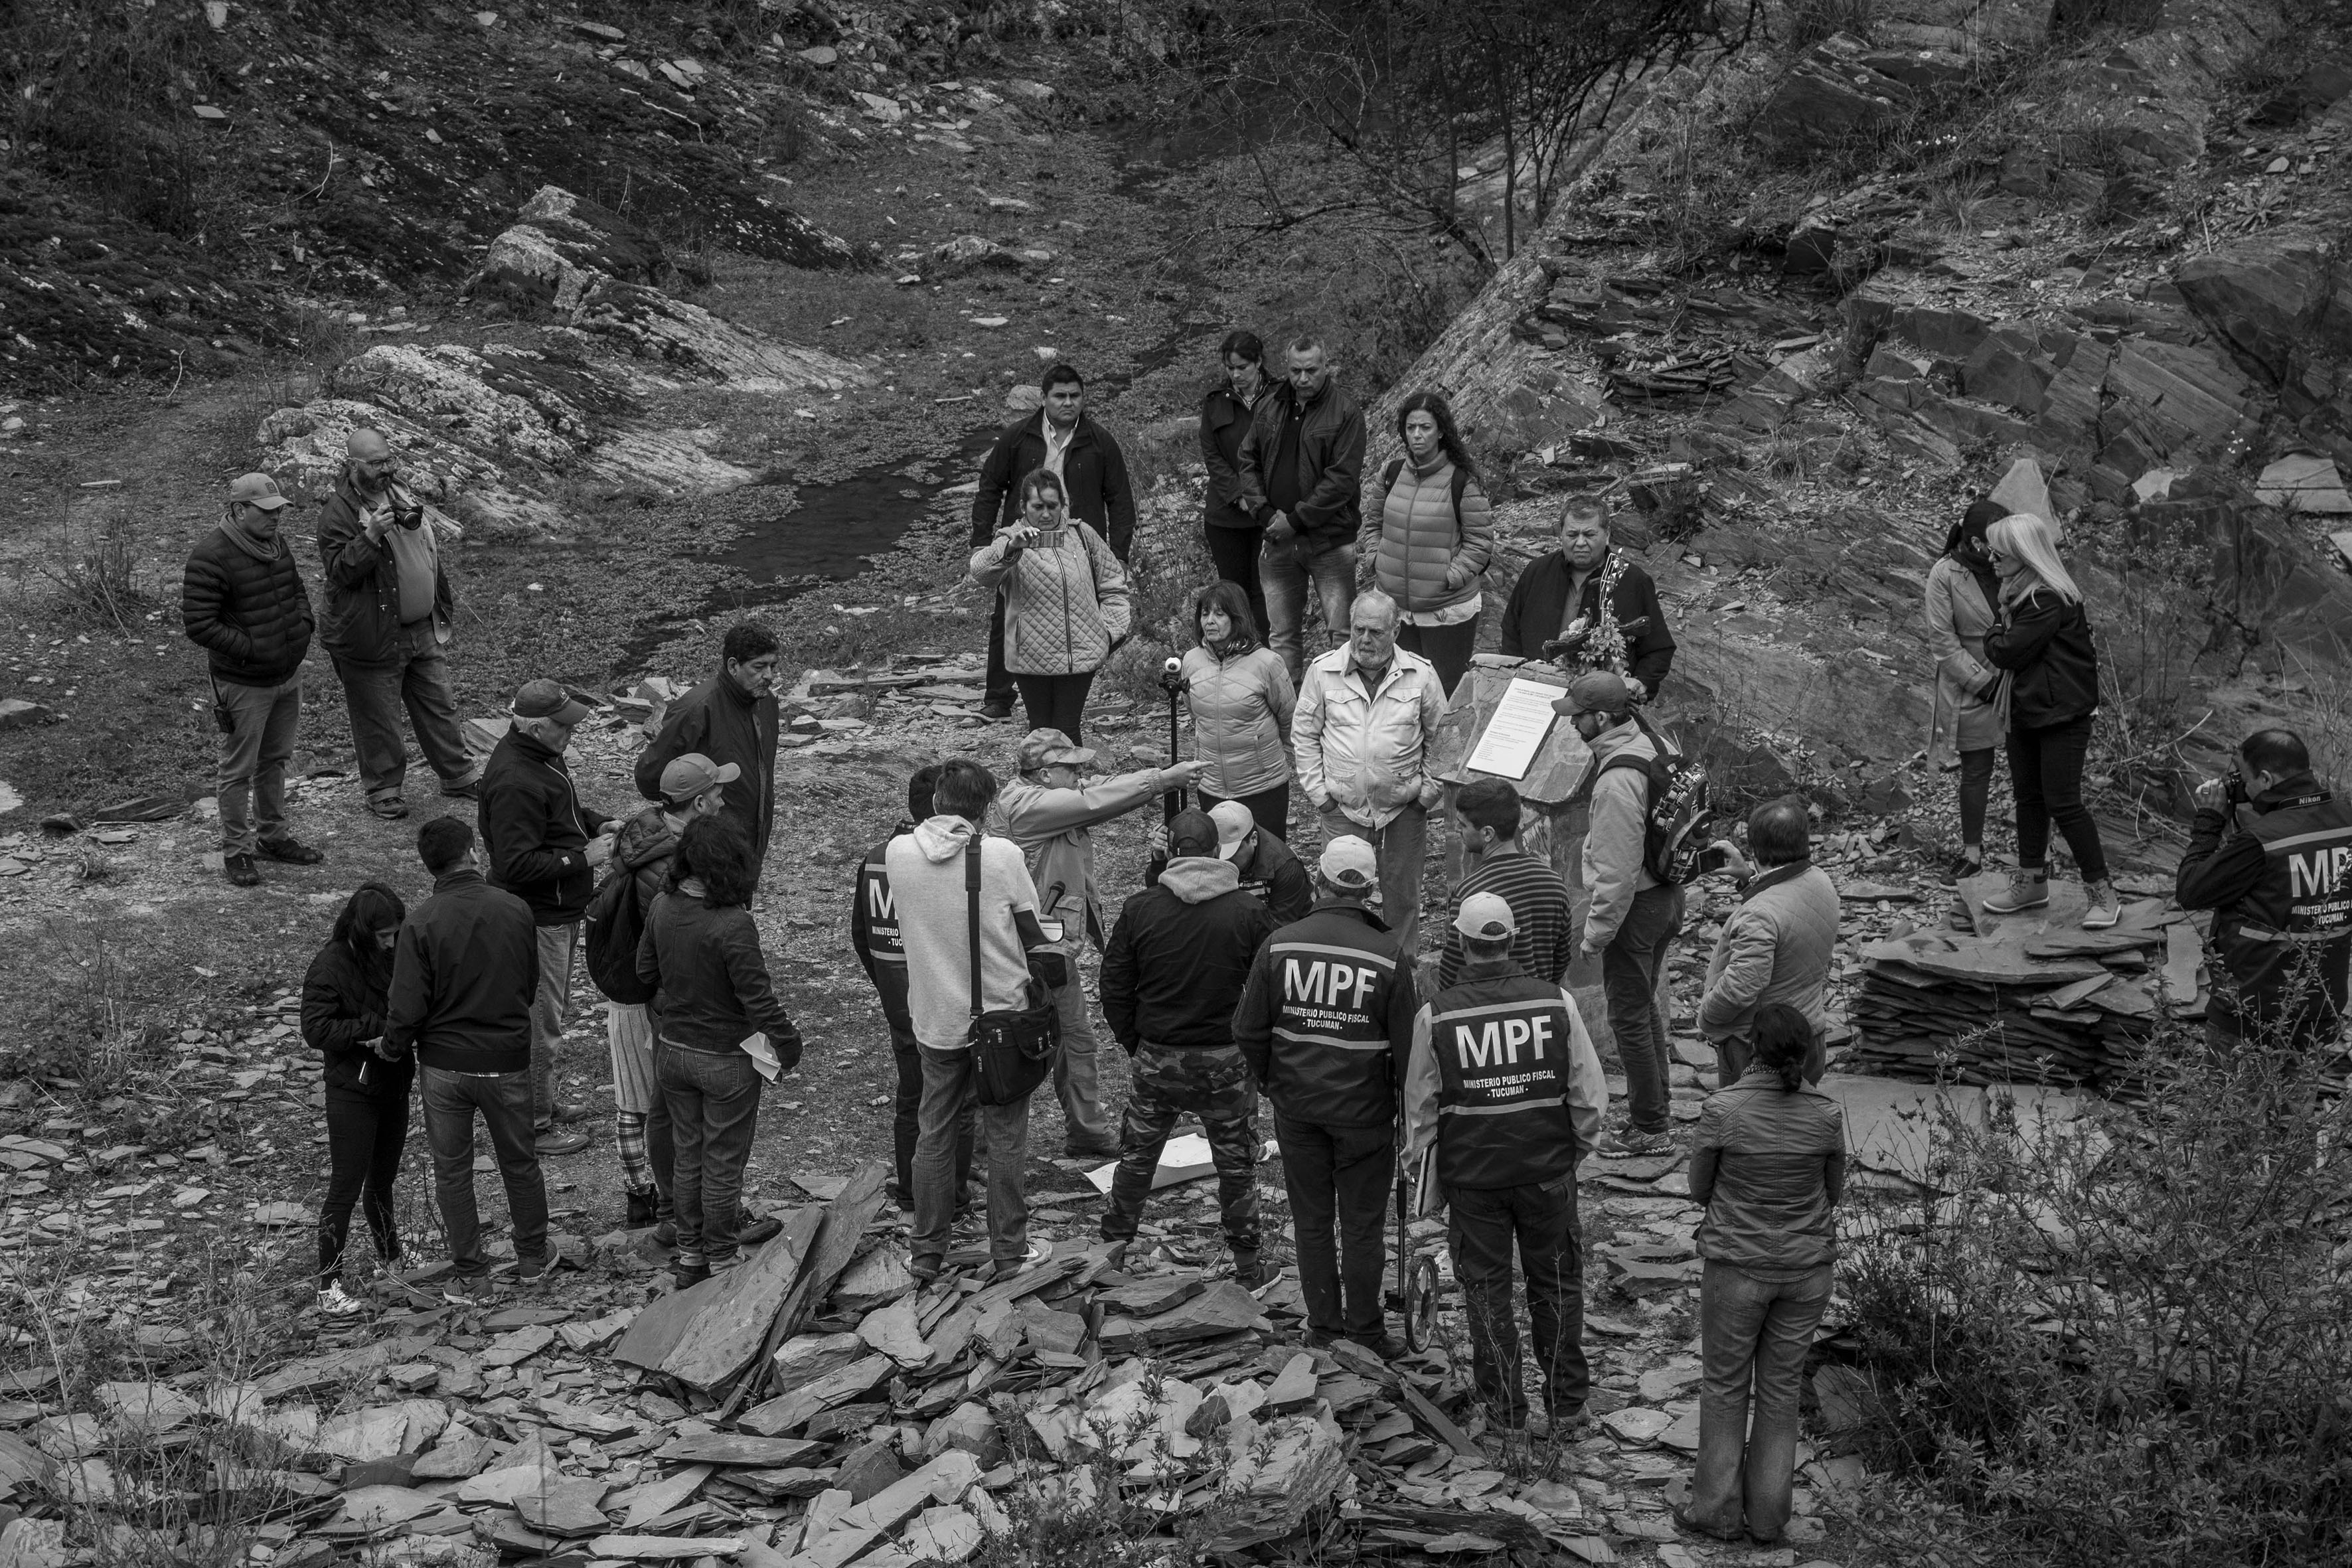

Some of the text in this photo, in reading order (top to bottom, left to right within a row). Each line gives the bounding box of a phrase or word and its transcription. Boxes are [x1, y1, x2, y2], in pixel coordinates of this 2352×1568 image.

[2299, 796, 2321, 805] Nikon
[2291, 905, 2327, 915] MINISTERO
[872, 925, 899, 937] MINISTERIO
[1285, 958, 1377, 1008] MPF
[1283, 1005, 1370, 1023] MINISTERIO PUBLICO FISCAL
[1306, 1018, 1340, 1030] TUCUMAN
[1456, 1015, 1553, 1068] MPF
[1463, 1069, 1555, 1089] MINISTERIO PUBLICO FISCAL
[1491, 1085, 1524, 1097] TUCUMAN
